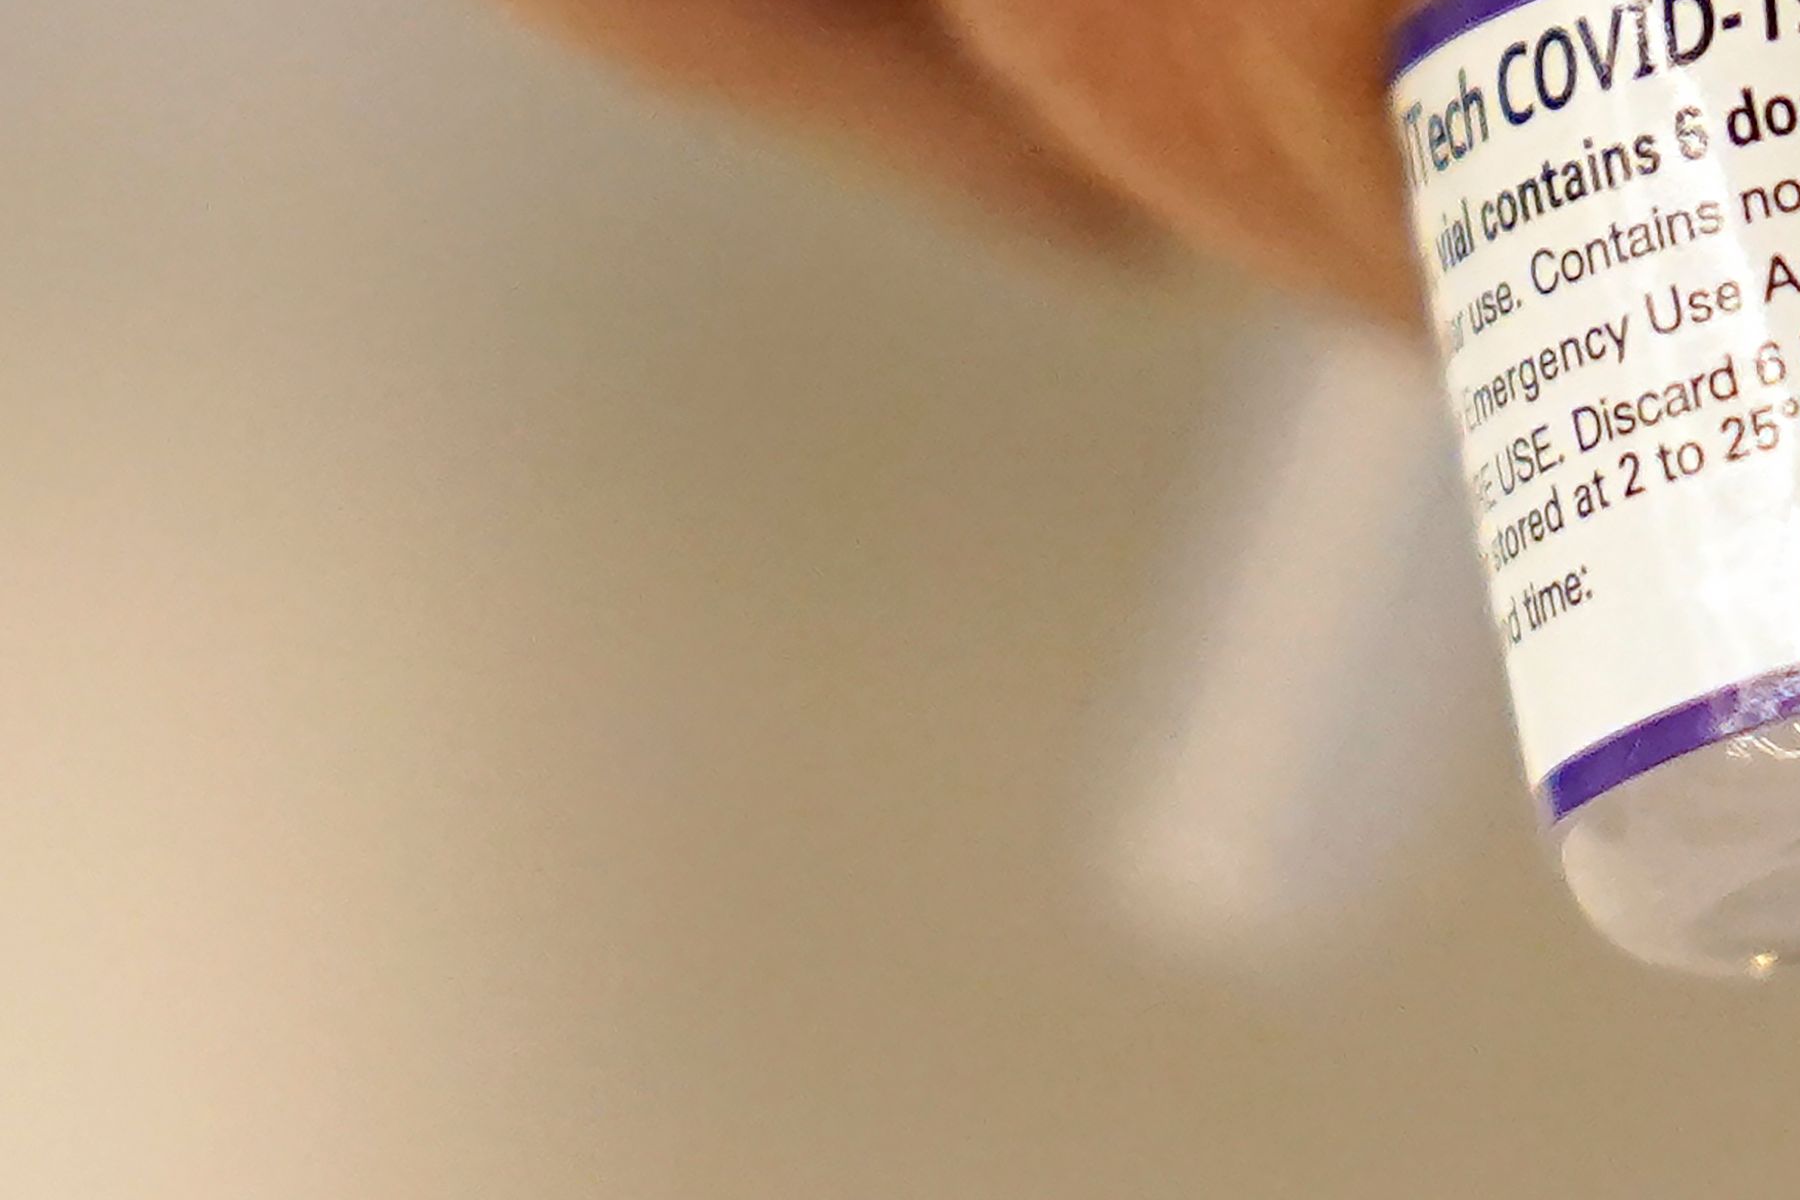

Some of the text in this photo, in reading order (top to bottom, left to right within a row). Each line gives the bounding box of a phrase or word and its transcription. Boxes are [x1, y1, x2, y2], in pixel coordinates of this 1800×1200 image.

[1481, 132, 1661, 241] contains
[1675, 105, 1708, 160] 6
[1469, 281, 1523, 335] use.
[1530, 200, 1724, 295] Contains
[1644, 280, 1743, 335] Use
[1496, 424, 1566, 497] USE.
[1572, 353, 1738, 453] Discard
[1756, 341, 1787, 386] 6
[1573, 470, 1611, 519] at
[1619, 452, 1646, 499] 2
[1657, 440, 1705, 483] to
[1524, 564, 1594, 632] time:
